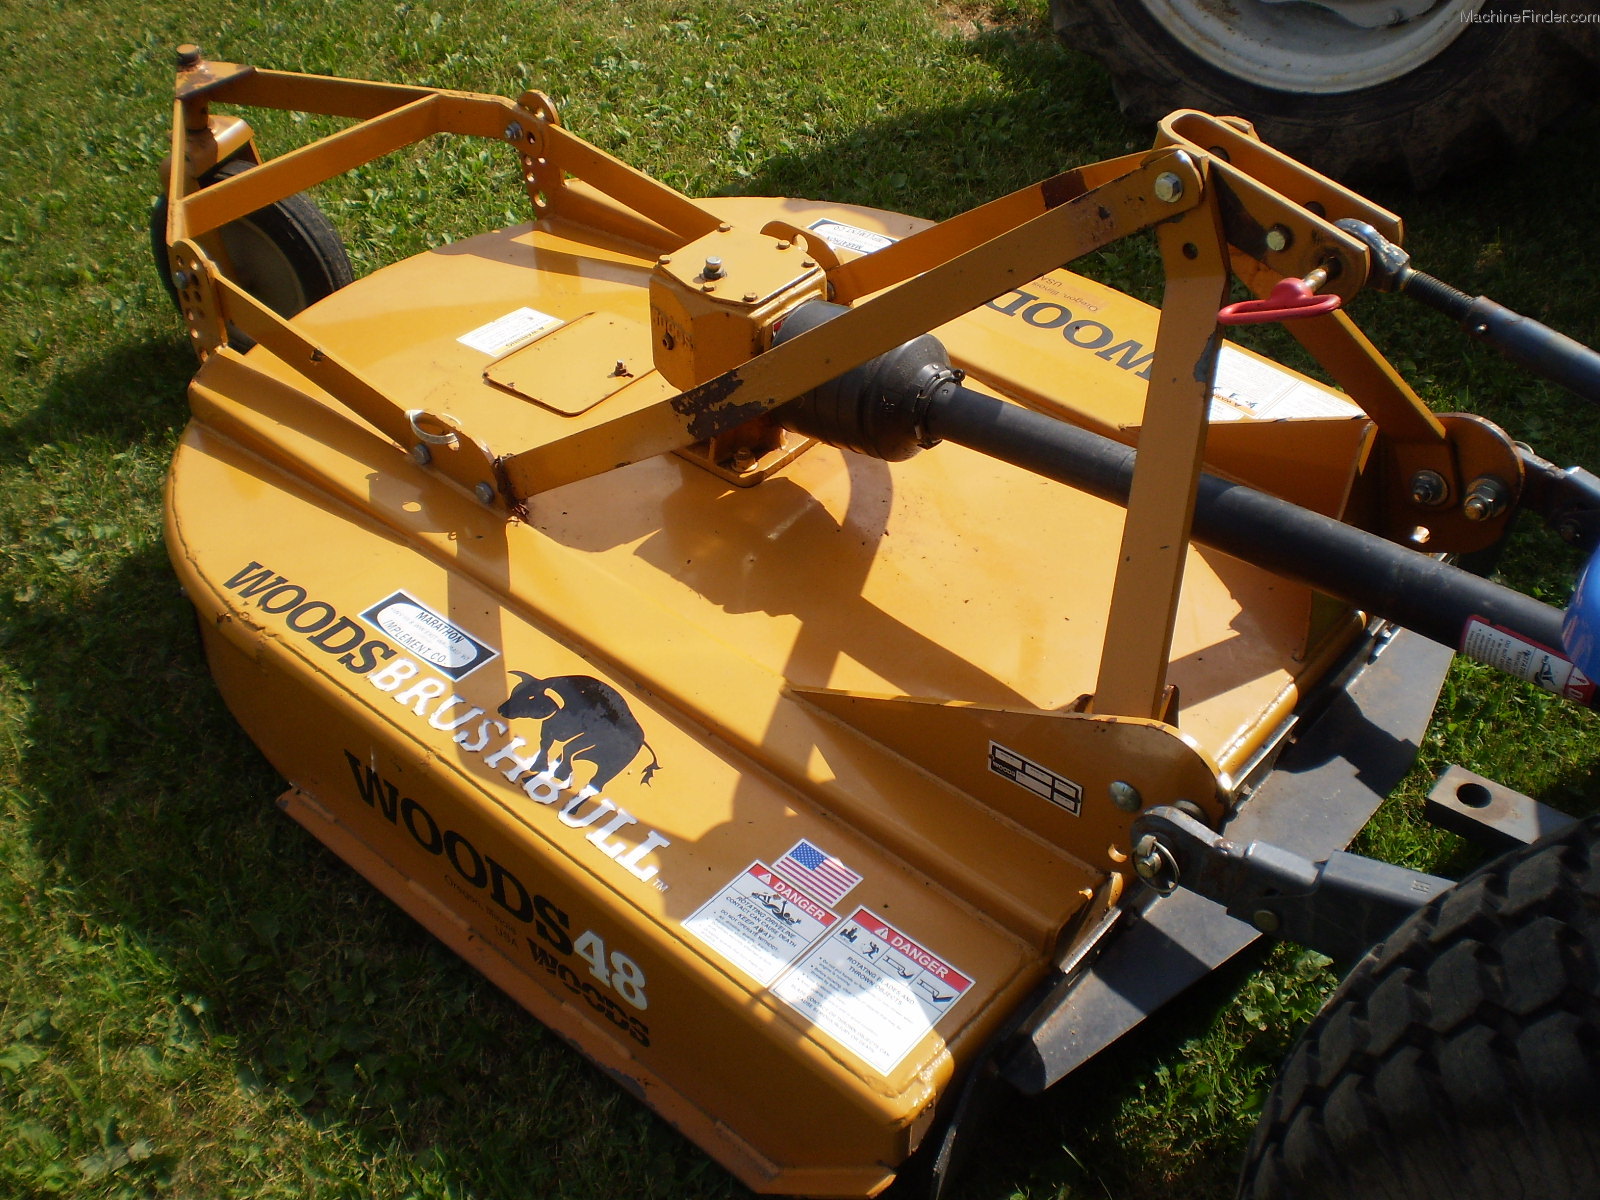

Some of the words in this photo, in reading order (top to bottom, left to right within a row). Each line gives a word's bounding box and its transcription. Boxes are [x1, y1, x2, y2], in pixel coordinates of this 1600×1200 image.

[985, 289, 1153, 381] WOOD
[223, 561, 398, 674] WOODS
[383, 619, 431, 657] IMPLEMENT
[415, 612, 465, 644] MARATHON
[344, 749, 574, 956] WOODS
[573, 930, 648, 1011] 48
[773, 880, 827, 921] DANGER
[725, 896, 750, 914] CONTACT
[748, 913, 761, 922] CAN
[760, 921, 778, 934] CAUSE
[777, 933, 797, 947] DEATH
[736, 913, 754, 926] KEEP
[846, 956, 877, 978] ROTATING
[847, 966, 875, 985] THROWN
[890, 935, 949, 979] DANGER
[527, 937, 650, 1048] WOODS
